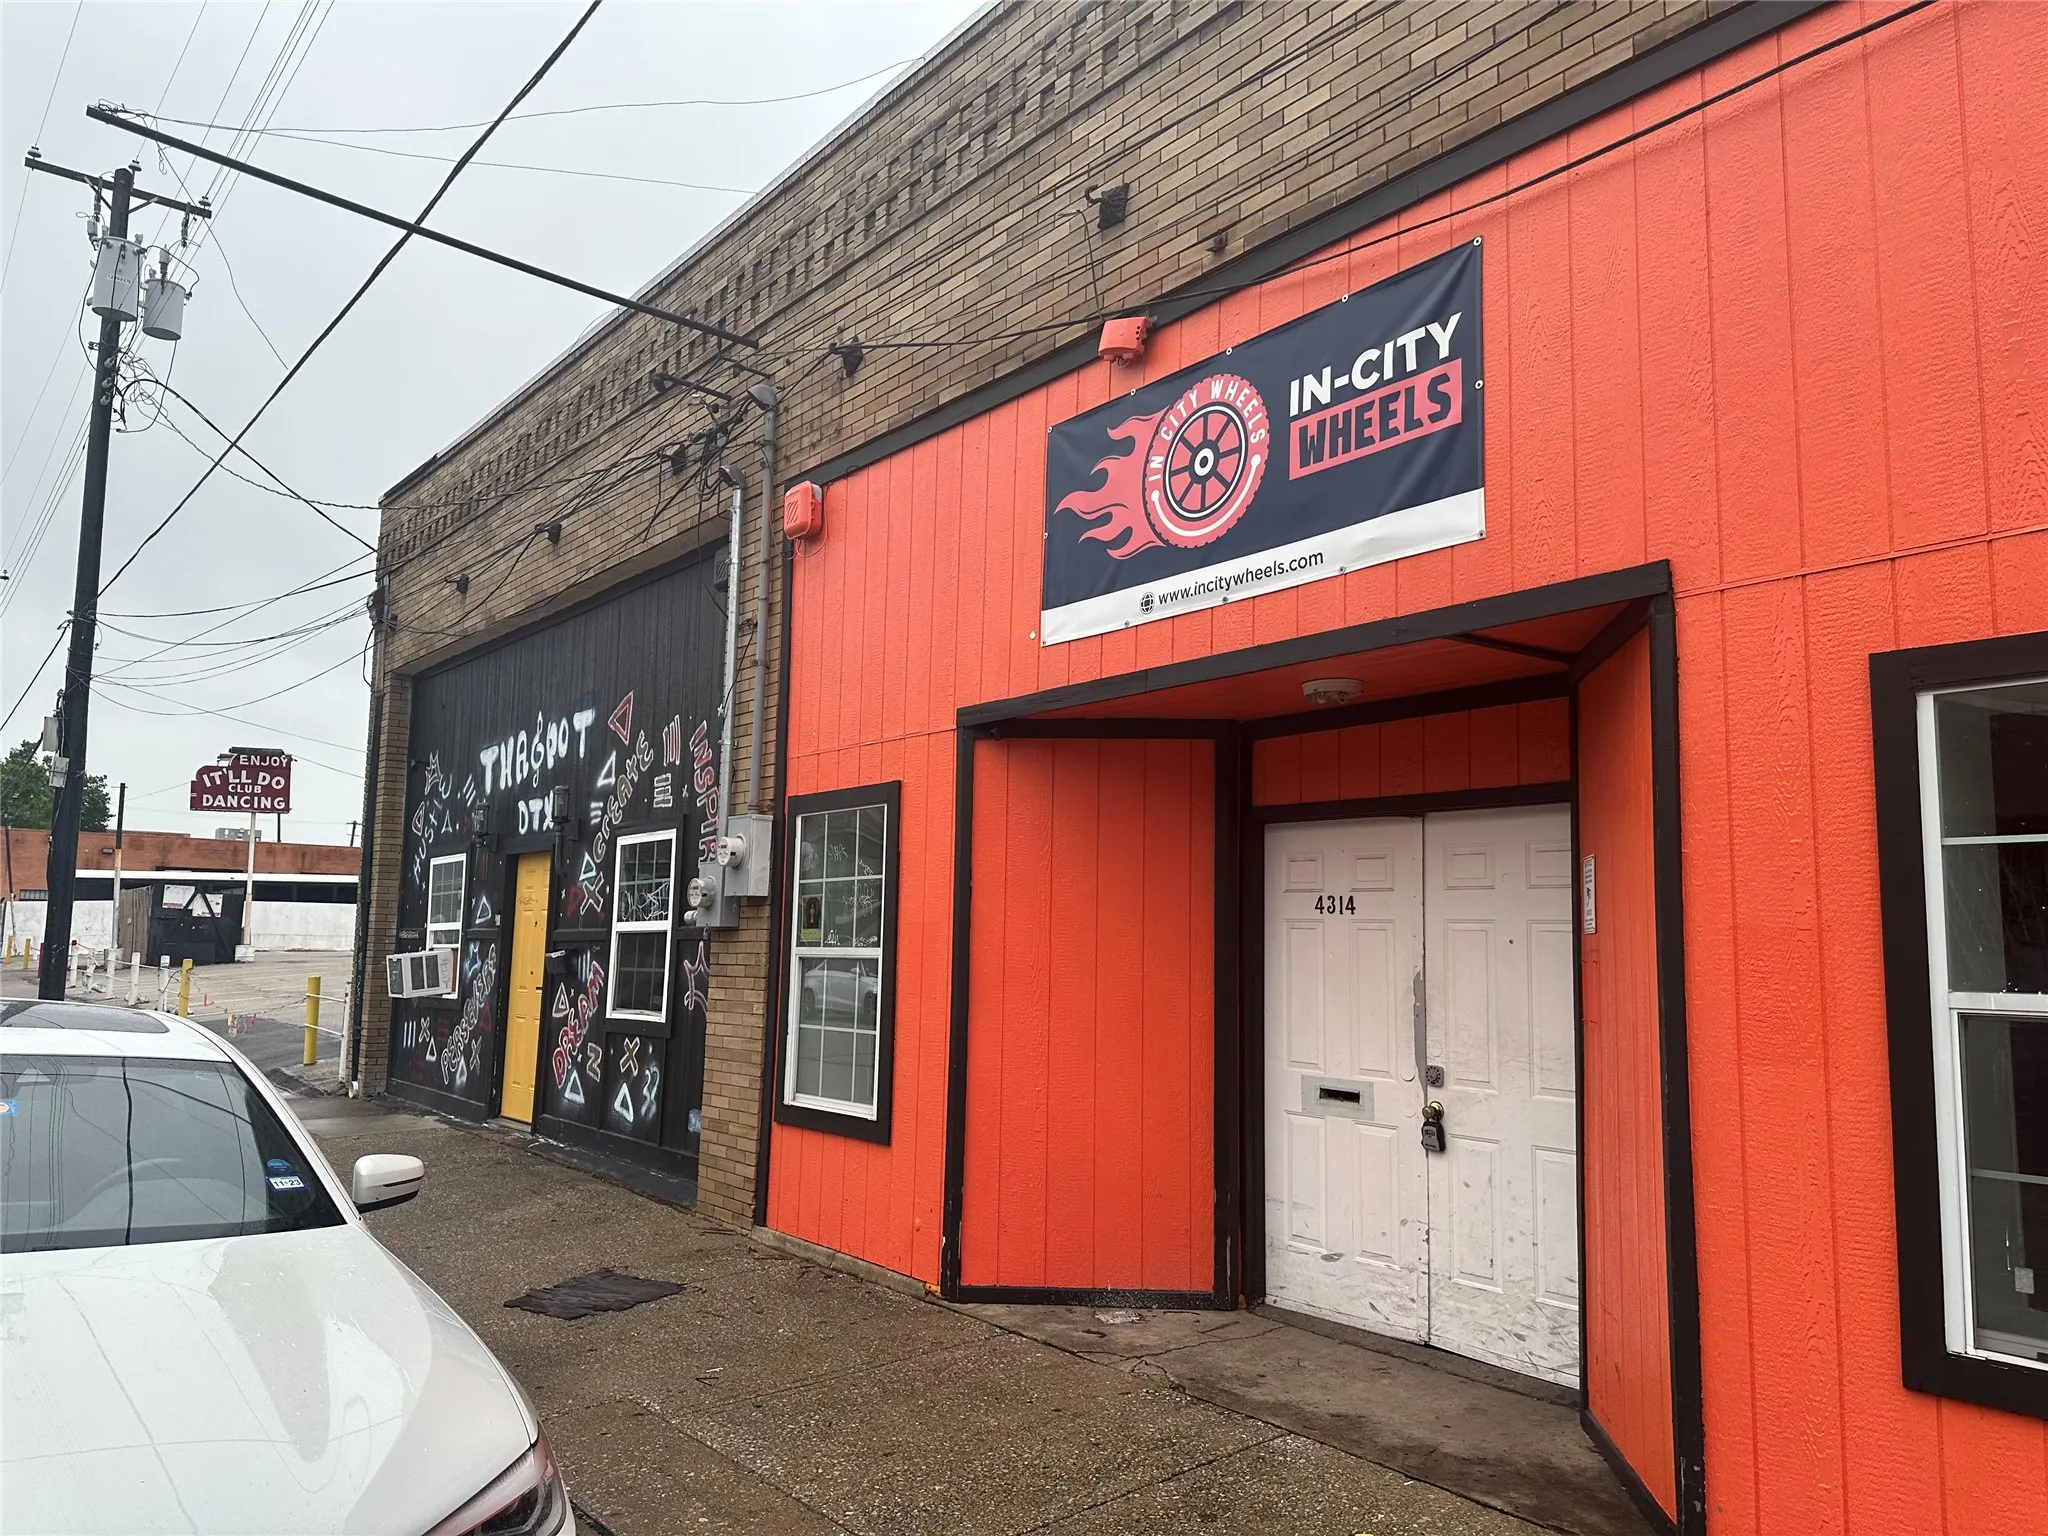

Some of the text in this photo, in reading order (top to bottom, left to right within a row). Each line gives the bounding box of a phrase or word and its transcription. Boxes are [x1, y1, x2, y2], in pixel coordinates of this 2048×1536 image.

[1290, 312, 1462, 417] IN-CITY
[1148, 379, 1267, 482] IN CITY WHEELS
[1298, 372, 1452, 470] WHEELS
[1158, 551, 1324, 605] www.incitywheels.com
[202, 768, 285, 790] IT'LL DO
[239, 754, 288, 767] ENJOY
[202, 794, 286, 809] DANCING
[228, 784, 262, 794] CLUB
[689, 719, 720, 866] INSPIR
[1315, 895, 1356, 915] 4314
